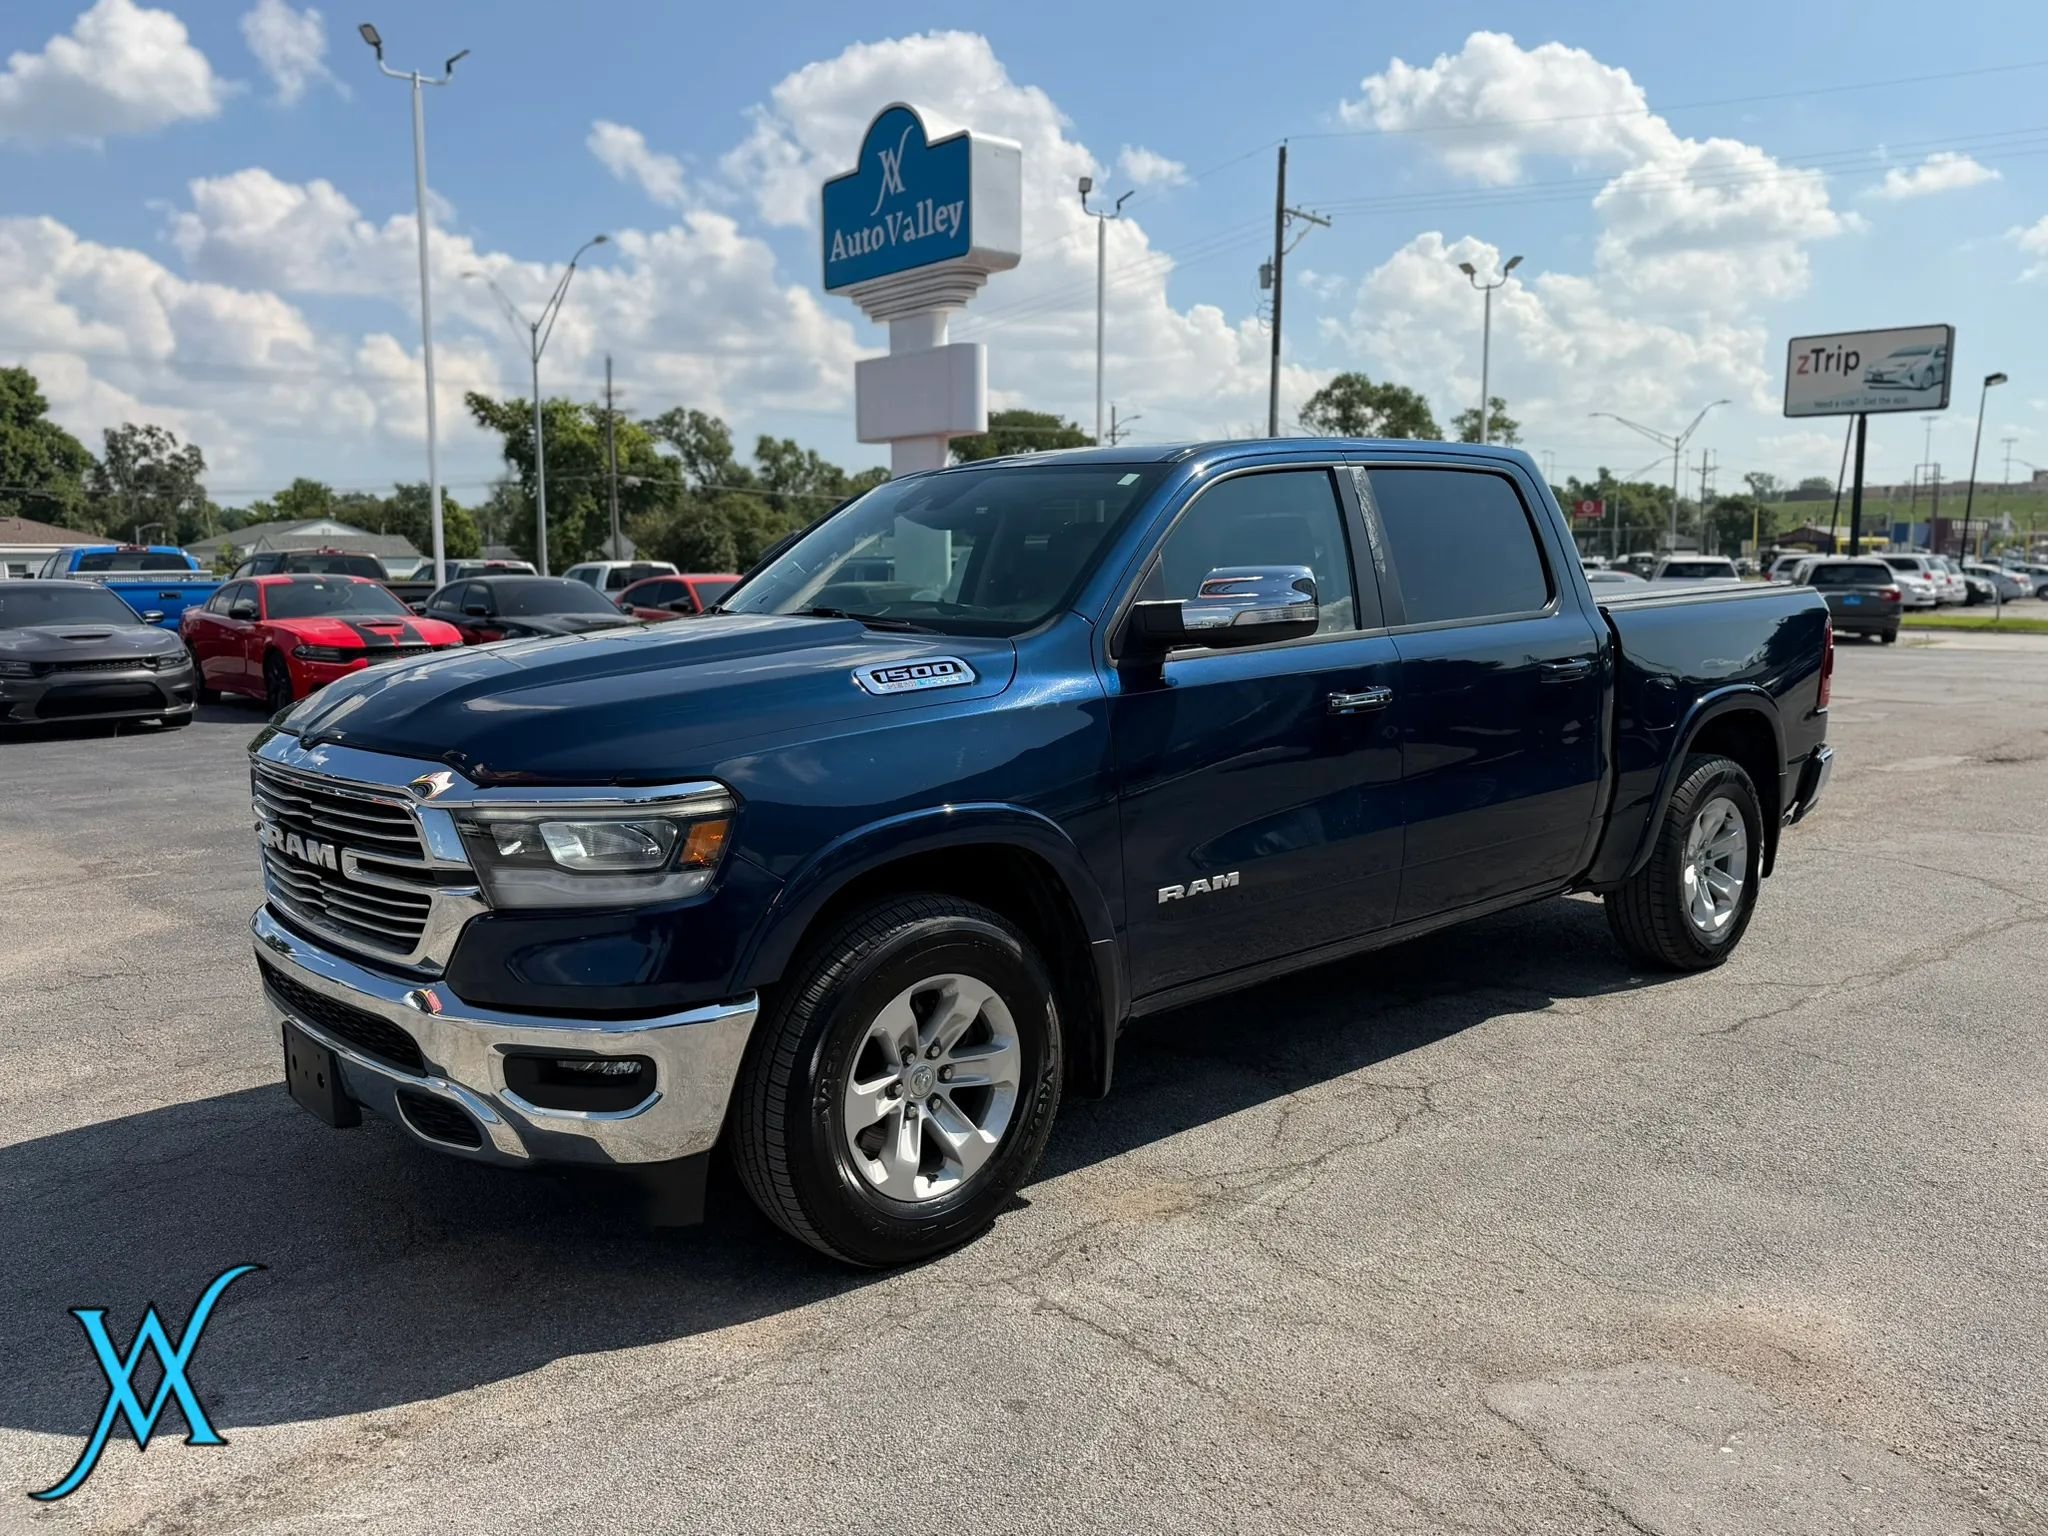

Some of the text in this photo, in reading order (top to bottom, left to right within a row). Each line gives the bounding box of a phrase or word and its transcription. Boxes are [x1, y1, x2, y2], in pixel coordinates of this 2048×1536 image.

[1796, 344, 1860, 377] zTrip
[871, 662, 955, 683] 1500
[259, 820, 338, 872] RAM
[1158, 871, 1240, 905] RAM
